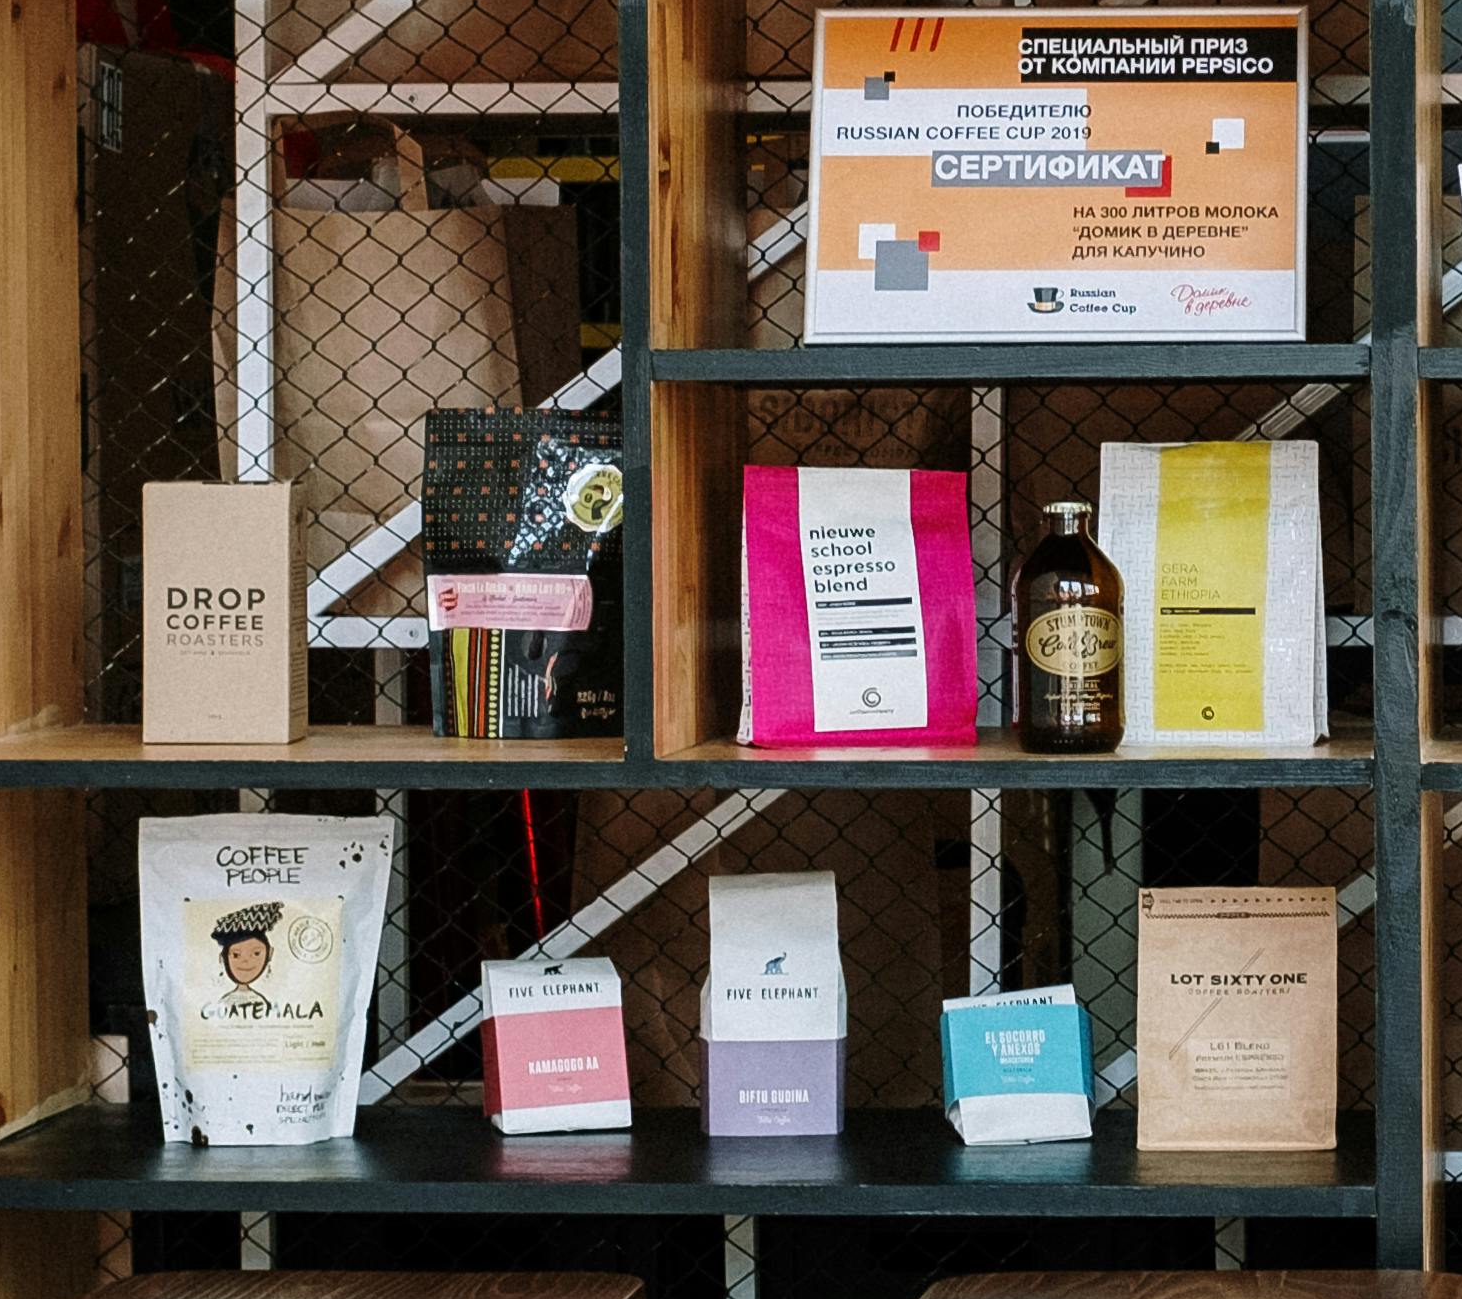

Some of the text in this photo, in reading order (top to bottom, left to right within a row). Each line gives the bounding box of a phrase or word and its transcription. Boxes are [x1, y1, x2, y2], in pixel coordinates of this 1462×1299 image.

[1018, 35, 1248, 59] СПЕЦИАЛЬНЫЙ ПРИЗ
[1018, 58, 1273, 74] ОТ КОМПАНИИ PEPSICO
[957, 104, 1092, 122] ПОБЕДИТЕЛЮ
[837, 126, 1091, 140] RUSSIAN COFFEE CUP 2019
[935, 154, 1166, 181] СЕРТИФИКАТ
[1073, 206, 1278, 220] НА 300 ЛИТРОВ МОЛОКА
[1147, 226, 1157, 238] В
[1072, 245, 1206, 261] ДЛЯ КАПУЧИНО
[1070, 289, 1116, 298] Russian
[1070, 303, 1136, 316] Coffee Cup
[810, 525, 876, 541] nieuwe
[811, 541, 873, 558] school
[813, 559, 896, 577] espresso
[1162, 564, 1198, 574] GERA
[814, 577, 868, 594] blend
[1162, 577, 1198, 587] FARM
[166, 587, 266, 611] DROP
[1161, 589, 1221, 600] ETHIOPIA
[166, 614, 264, 631] COFFEE
[166, 633, 264, 648] ROASTERS
[215, 845, 309, 867] COFFEE
[225, 867, 302, 887] PEOPLE
[1170, 972, 1309, 986] LOT SIXTY ONE
[509, 986, 534, 999] FIVE
[727, 988, 753, 1000] FIVE
[200, 1001, 323, 1020] GUATEMALA
[985, 1030, 1045, 1045] EL SOCORRO
[528, 1057, 599, 1076] KAMAGOGO AA
